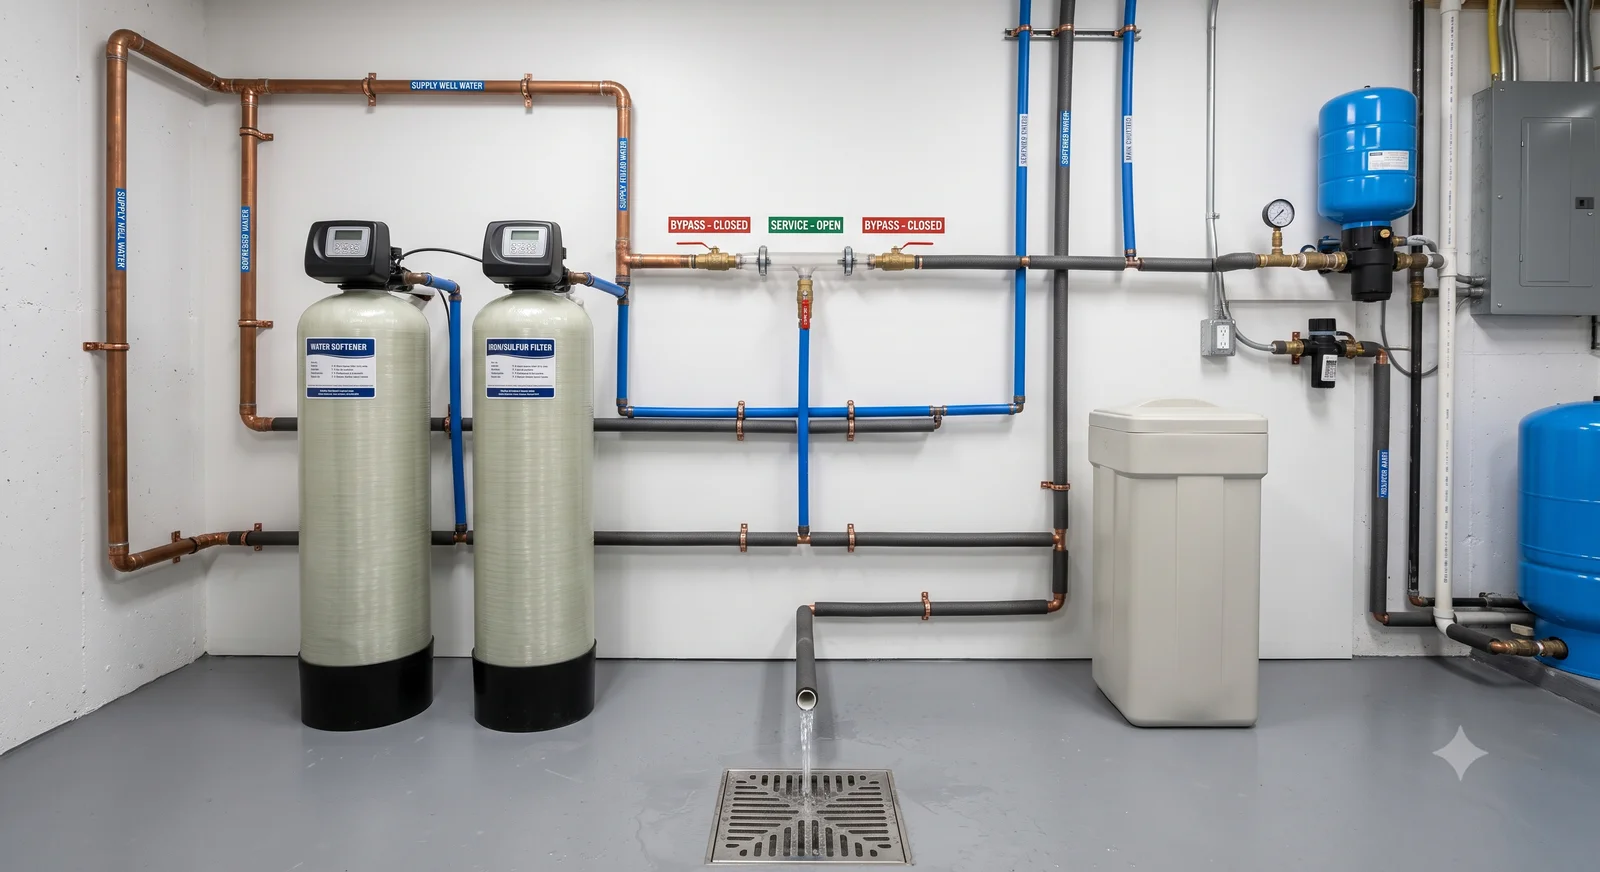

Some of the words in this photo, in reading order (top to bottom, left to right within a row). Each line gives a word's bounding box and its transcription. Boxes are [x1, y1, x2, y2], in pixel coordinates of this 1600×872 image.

[411, 81, 438, 90] SUPPLY
[439, 81, 459, 90] WELL
[459, 81, 483, 90] WATER
[619, 184, 627, 209] SUPPLY
[117, 191, 126, 221] SUPPLY
[670, 219, 706, 230] BYPASS
[713, 219, 748, 230] CLOSED
[770, 219, 809, 230] SERVICE
[816, 219, 841, 230] OPEN
[864, 220, 900, 231] BYPASS
[907, 220, 942, 231] CLOSED
[117, 241, 126, 268] WATER
[310, 343, 331, 351] WATER
[331, 343, 367, 351] SOFTENER
[488, 343, 529, 351] IRON/SULFUR
[530, 343, 553, 351] FILTER
